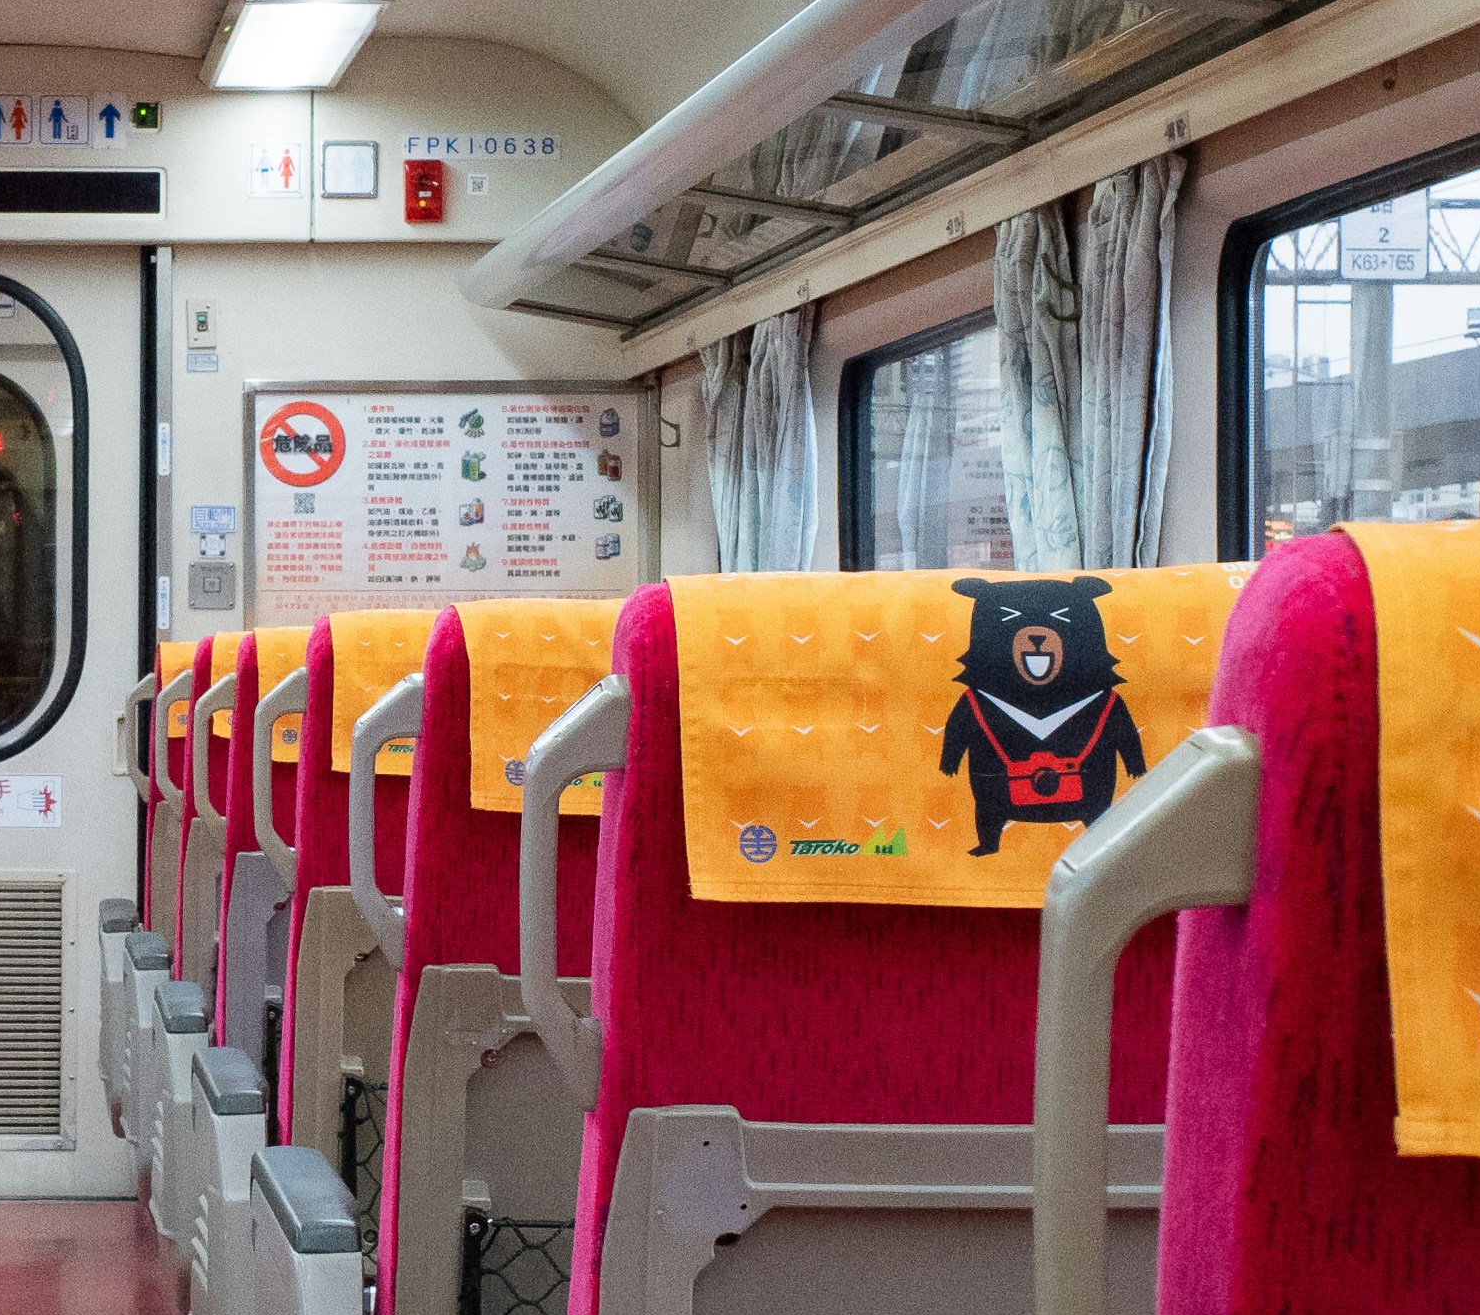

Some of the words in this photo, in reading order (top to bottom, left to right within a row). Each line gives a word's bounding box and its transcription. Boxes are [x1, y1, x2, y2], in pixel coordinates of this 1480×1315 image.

[407, 136, 556, 155] FPK10638
[1379, 227, 1389, 243] 2
[789, 839, 860, 856] Taroko
